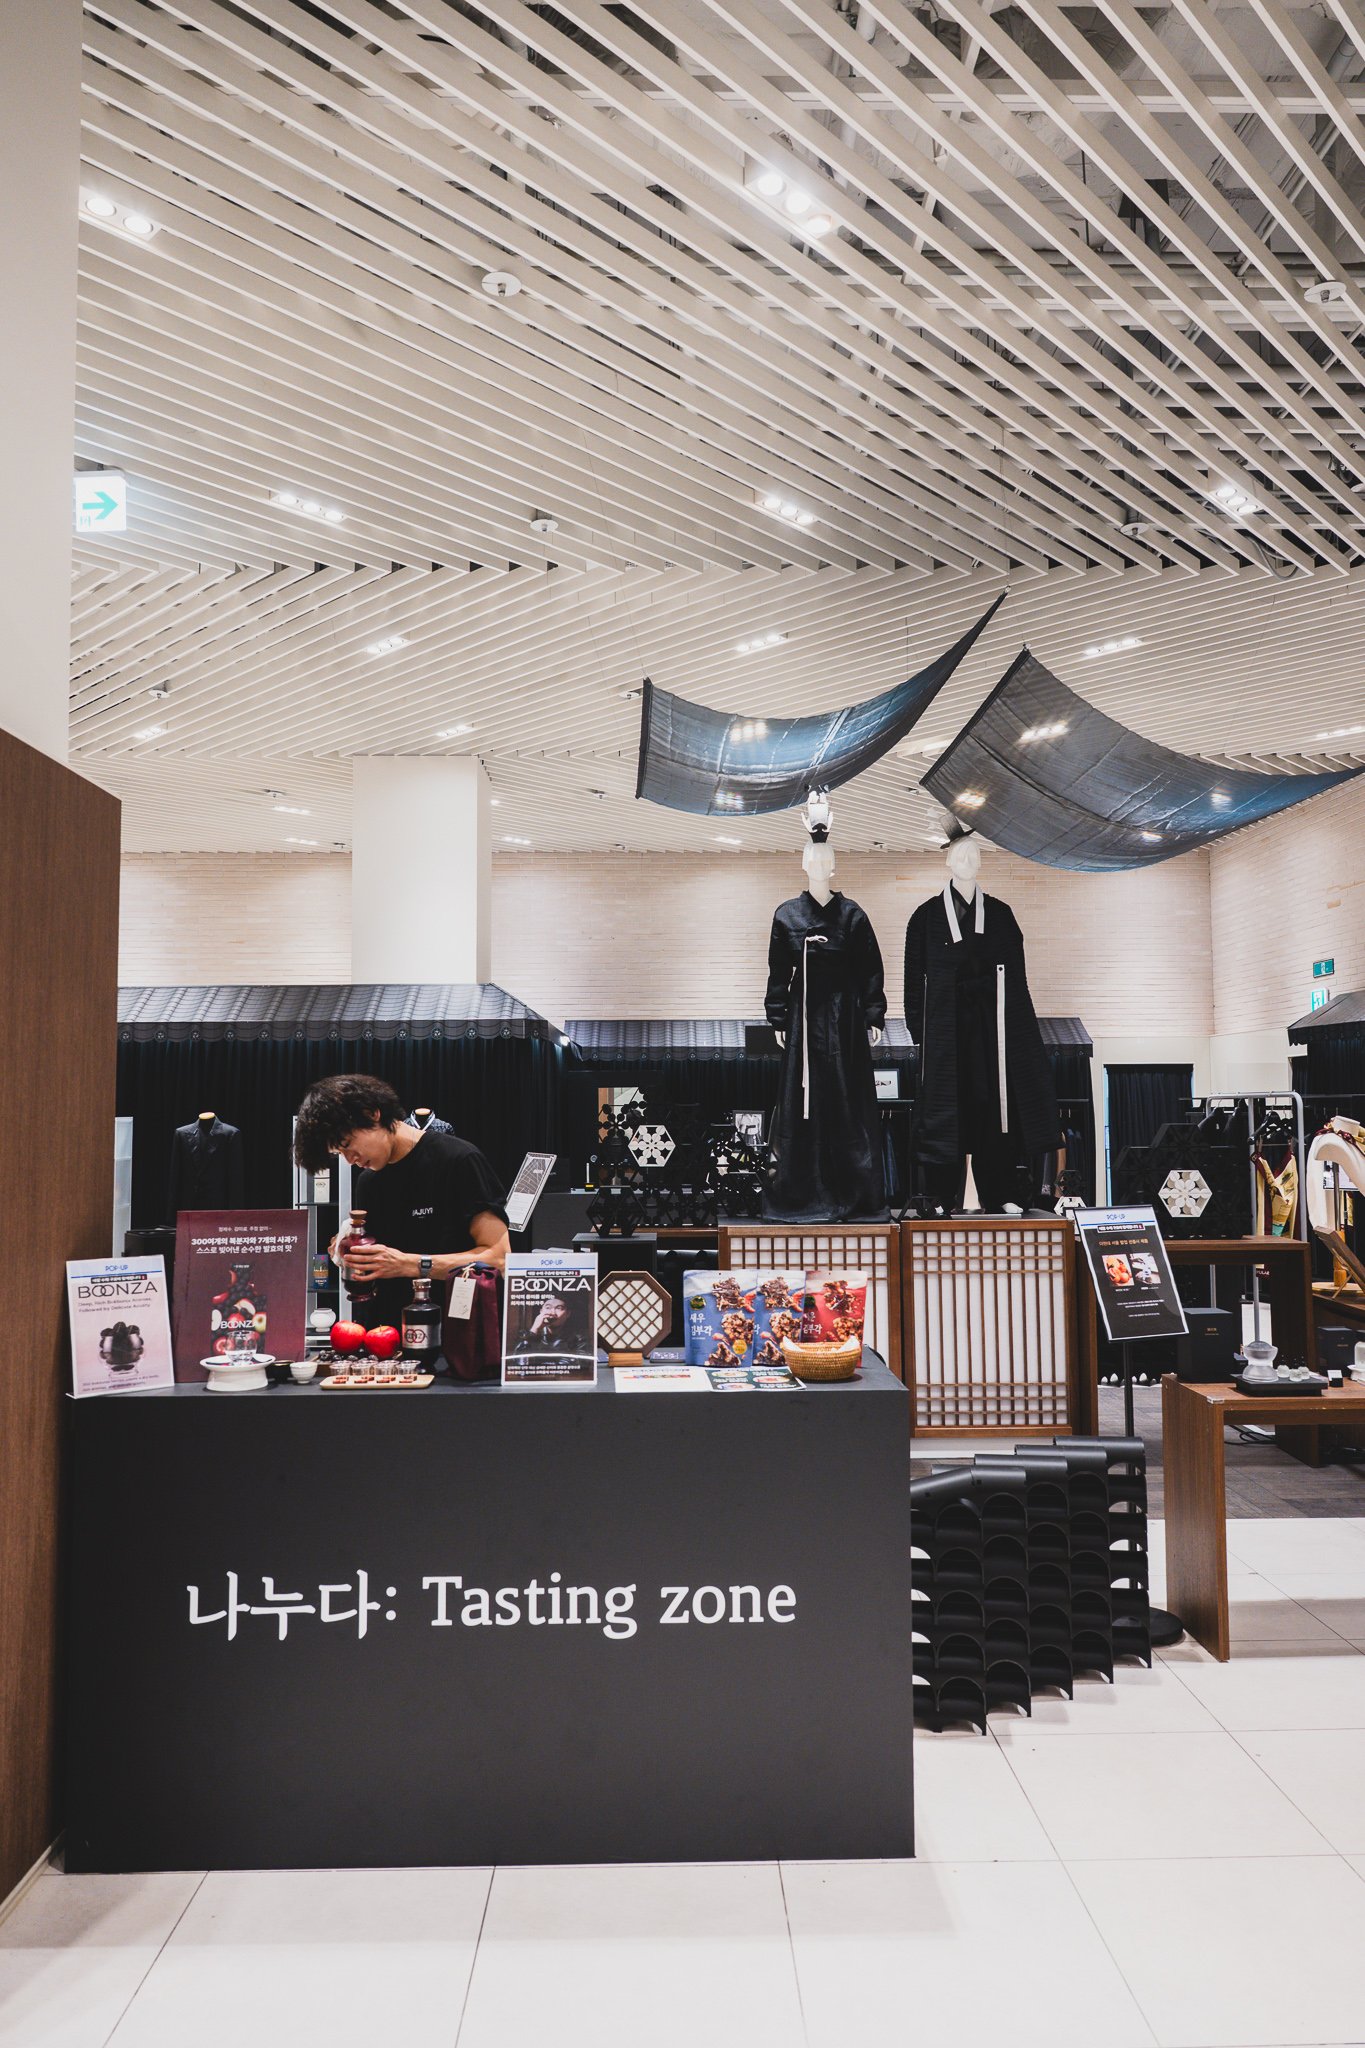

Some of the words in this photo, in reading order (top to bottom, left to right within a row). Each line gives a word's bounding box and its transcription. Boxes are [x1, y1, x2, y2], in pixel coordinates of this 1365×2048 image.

[229, 1236, 257, 1245] 복분자와
[257, 1236, 276, 1244] 7개의
[277, 1235, 298, 1244] 사과가
[196, 1246, 218, 1254] 스스로
[218, 1245, 240, 1254] 빚어낸
[241, 1245, 262, 1254] 순수한
[263, 1244, 284, 1253] 발효의
[284, 1244, 293, 1253] 맛
[78, 1281, 158, 1299] BOONZA
[511, 1278, 592, 1292] BOONZA
[689, 1312, 706, 1324] 새우
[690, 1325, 713, 1337] 김부각
[802, 1323, 823, 1335] 김부각
[186, 1569, 398, 1641] 나누다:
[421, 1571, 637, 1640] Tasting
[659, 1583, 797, 1625] zone
